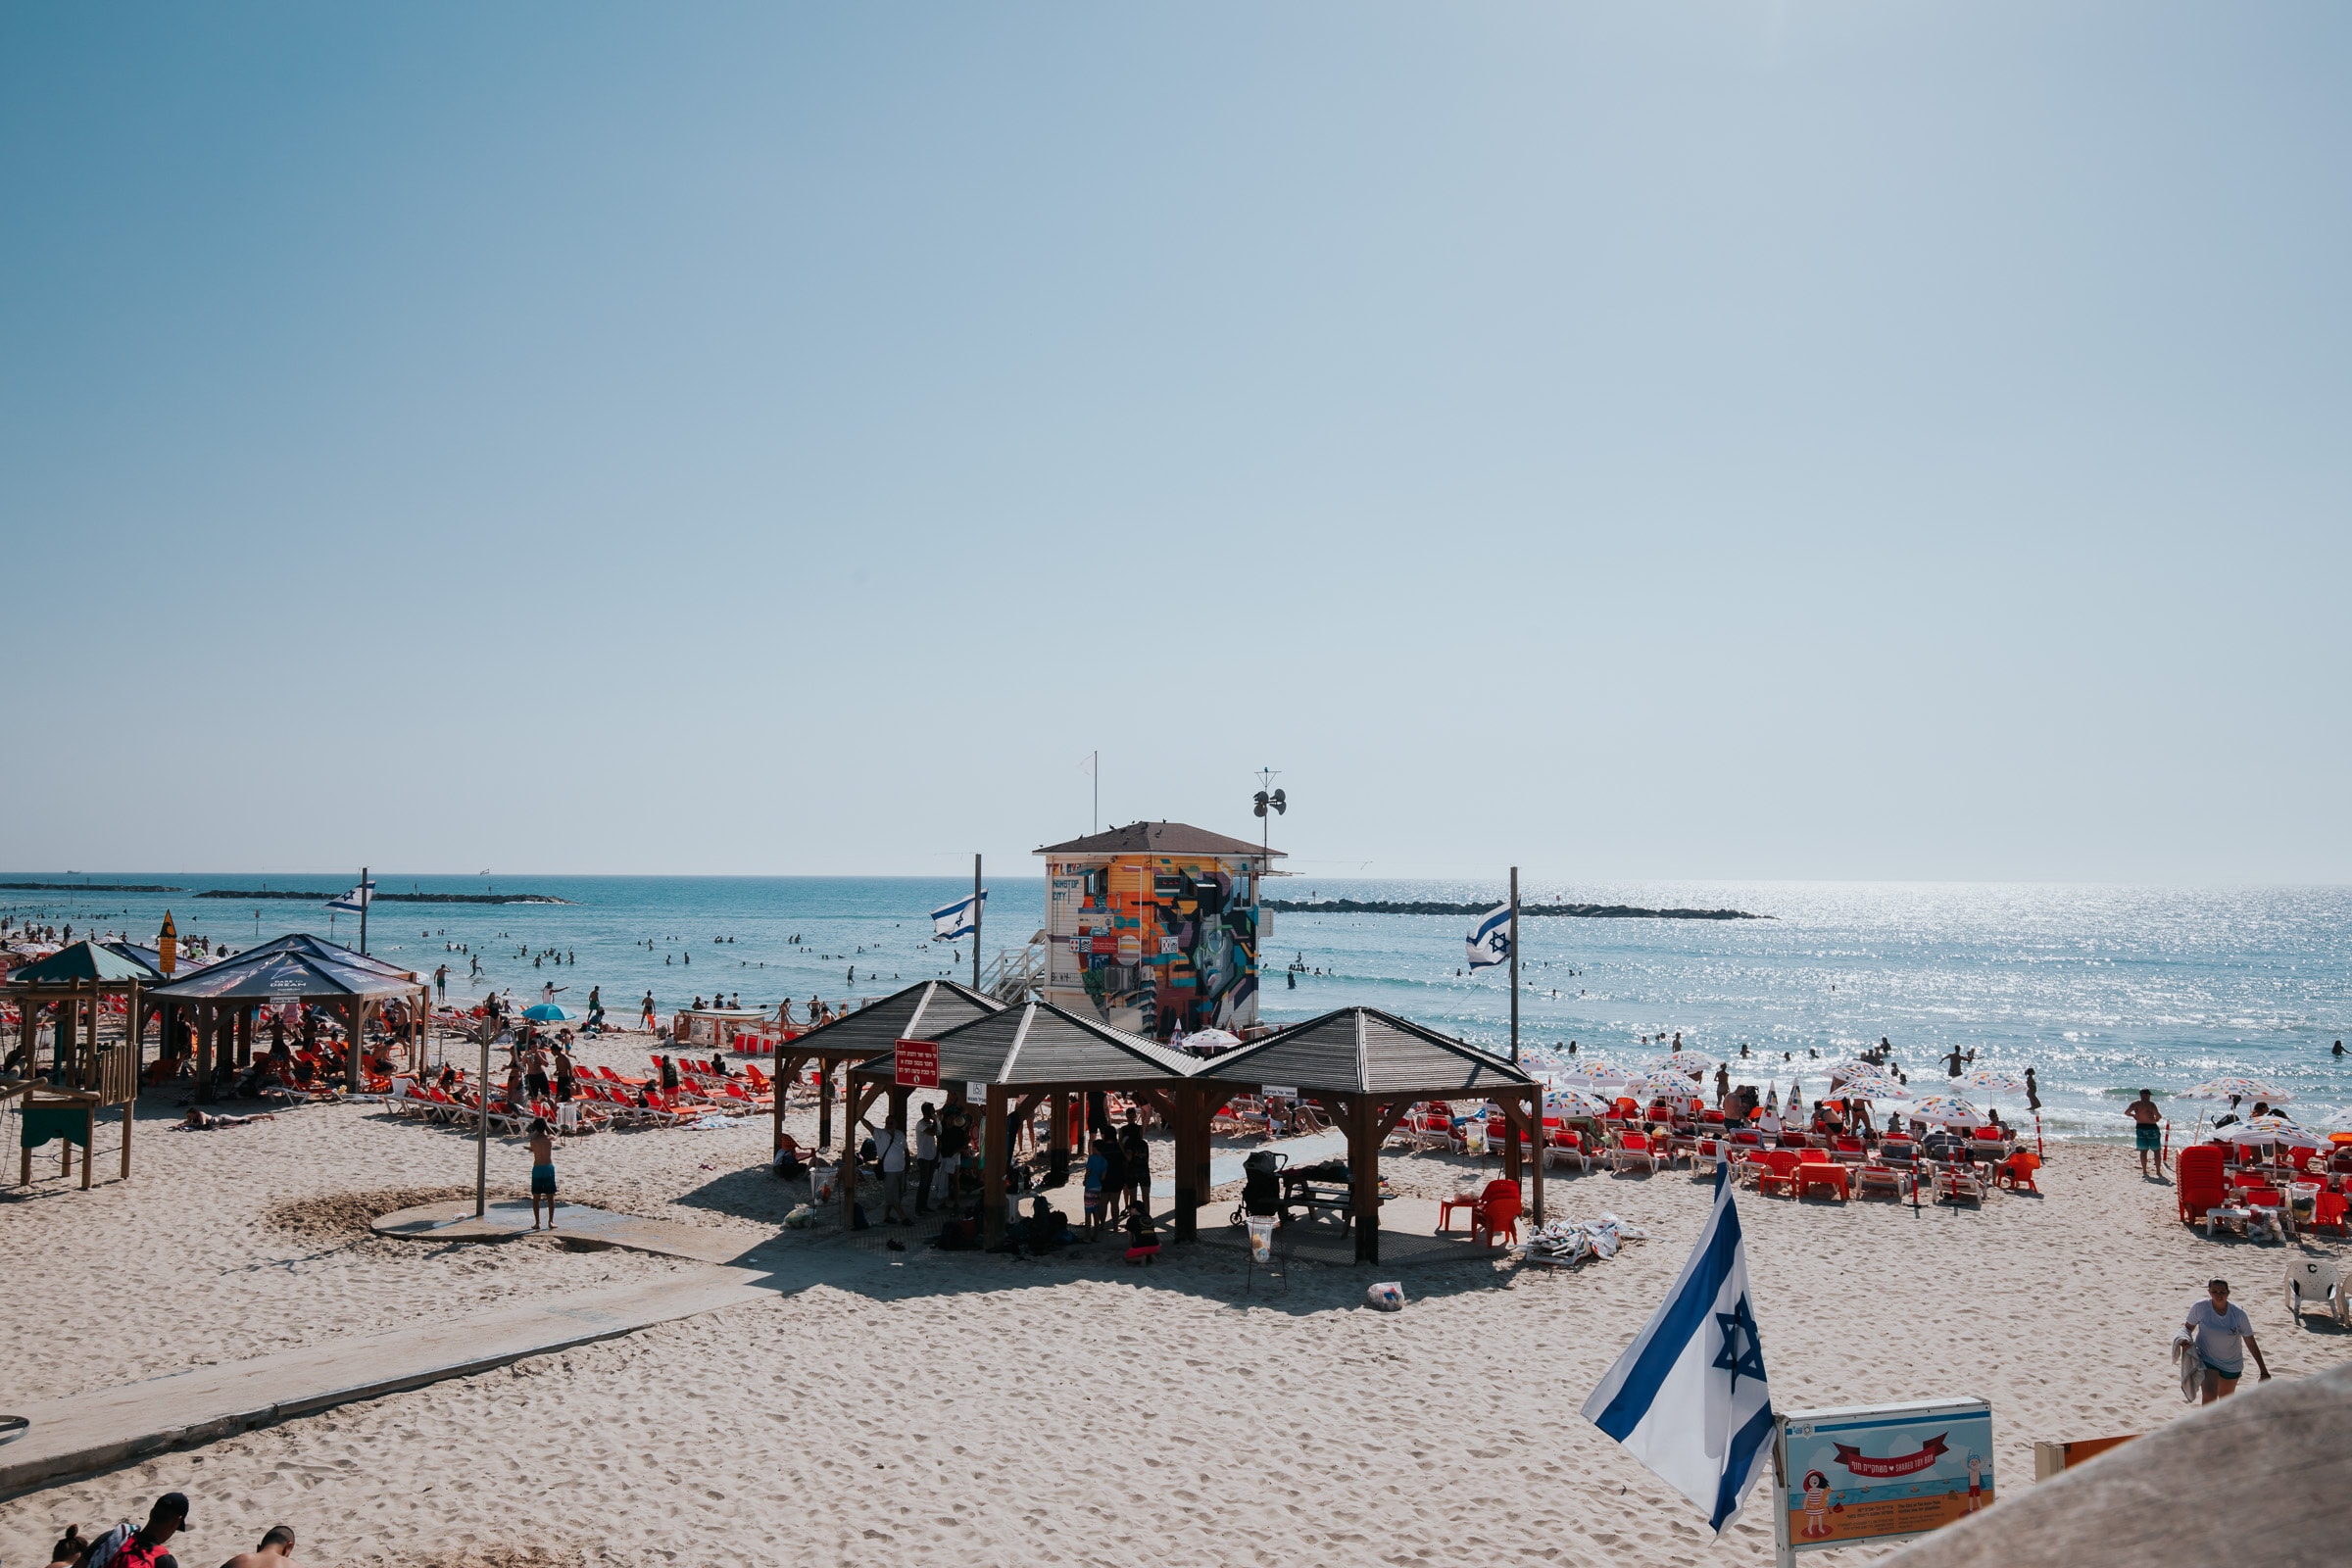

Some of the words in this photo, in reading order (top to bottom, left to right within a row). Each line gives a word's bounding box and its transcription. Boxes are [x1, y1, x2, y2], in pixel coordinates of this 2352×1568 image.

[1851, 1460, 1862, 1471] חוף
[1895, 1460, 1914, 1472] SHARED
[1914, 1457, 1924, 1468] TOY
[1924, 1453, 1934, 1464] BOX
